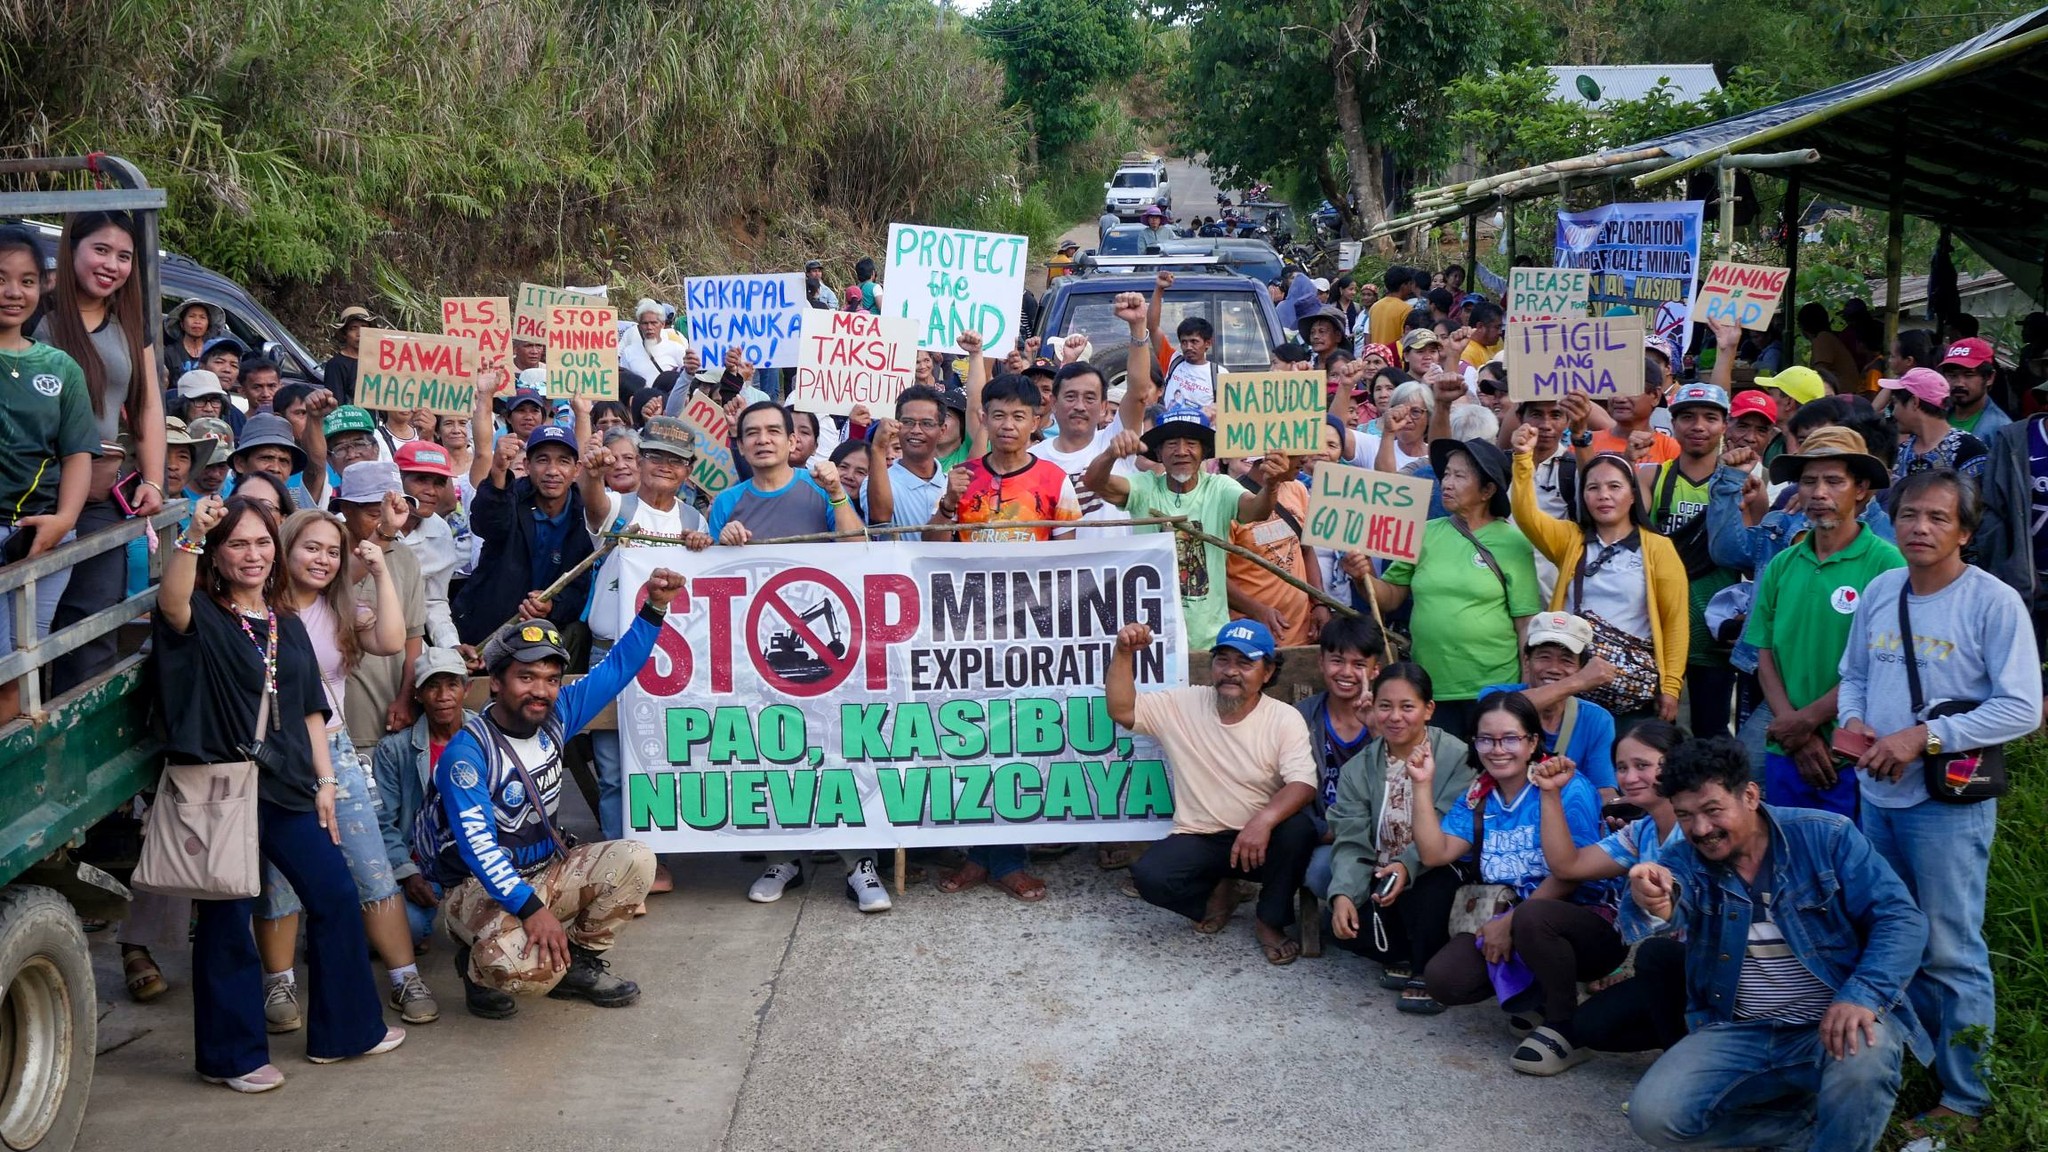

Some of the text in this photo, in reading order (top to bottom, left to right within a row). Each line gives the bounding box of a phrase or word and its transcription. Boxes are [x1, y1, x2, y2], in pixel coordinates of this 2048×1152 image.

[896, 228, 1025, 278] PROTECT
[1646, 250, 1692, 275] MINING
[927, 270, 970, 301] the
[1514, 272, 1585, 293] PLEASE
[1708, 265, 1787, 293] MINING
[687, 279, 795, 312] KAKAPAL
[1514, 293, 1569, 313] PRAY
[1706, 297, 1762, 325] BAD
[444, 301, 500, 325] PLS.
[553, 309, 612, 327] STOP
[692, 312, 802, 342] NG MUKA
[832, 313, 881, 337] MGA
[549, 329, 617, 351] MINING
[702, 337, 779, 369] NIO!
[1524, 321, 1626, 354] ITIGIL
[379, 339, 471, 377] BAWAL
[561, 352, 602, 368] OUR
[812, 336, 911, 373] TAKSIL
[1554, 353, 1593, 369] ANG
[361, 374, 474, 414] MAGMINA
[550, 369, 613, 395] HOME
[1534, 368, 1617, 396] MINA
[1226, 417, 1322, 451] MO KAMI
[1323, 471, 1415, 507] LIARS
[1311, 505, 1338, 540] GO
[1345, 509, 1365, 545] TO
[1366, 514, 1416, 560] HELL
[930, 565, 1162, 643] MINING
[635, 566, 921, 699] STOP
[665, 695, 1136, 768] PAO, KASIBU,
[629, 758, 1175, 832] NUEVA VIZCAYA
[459, 804, 521, 897] YAMAHA
